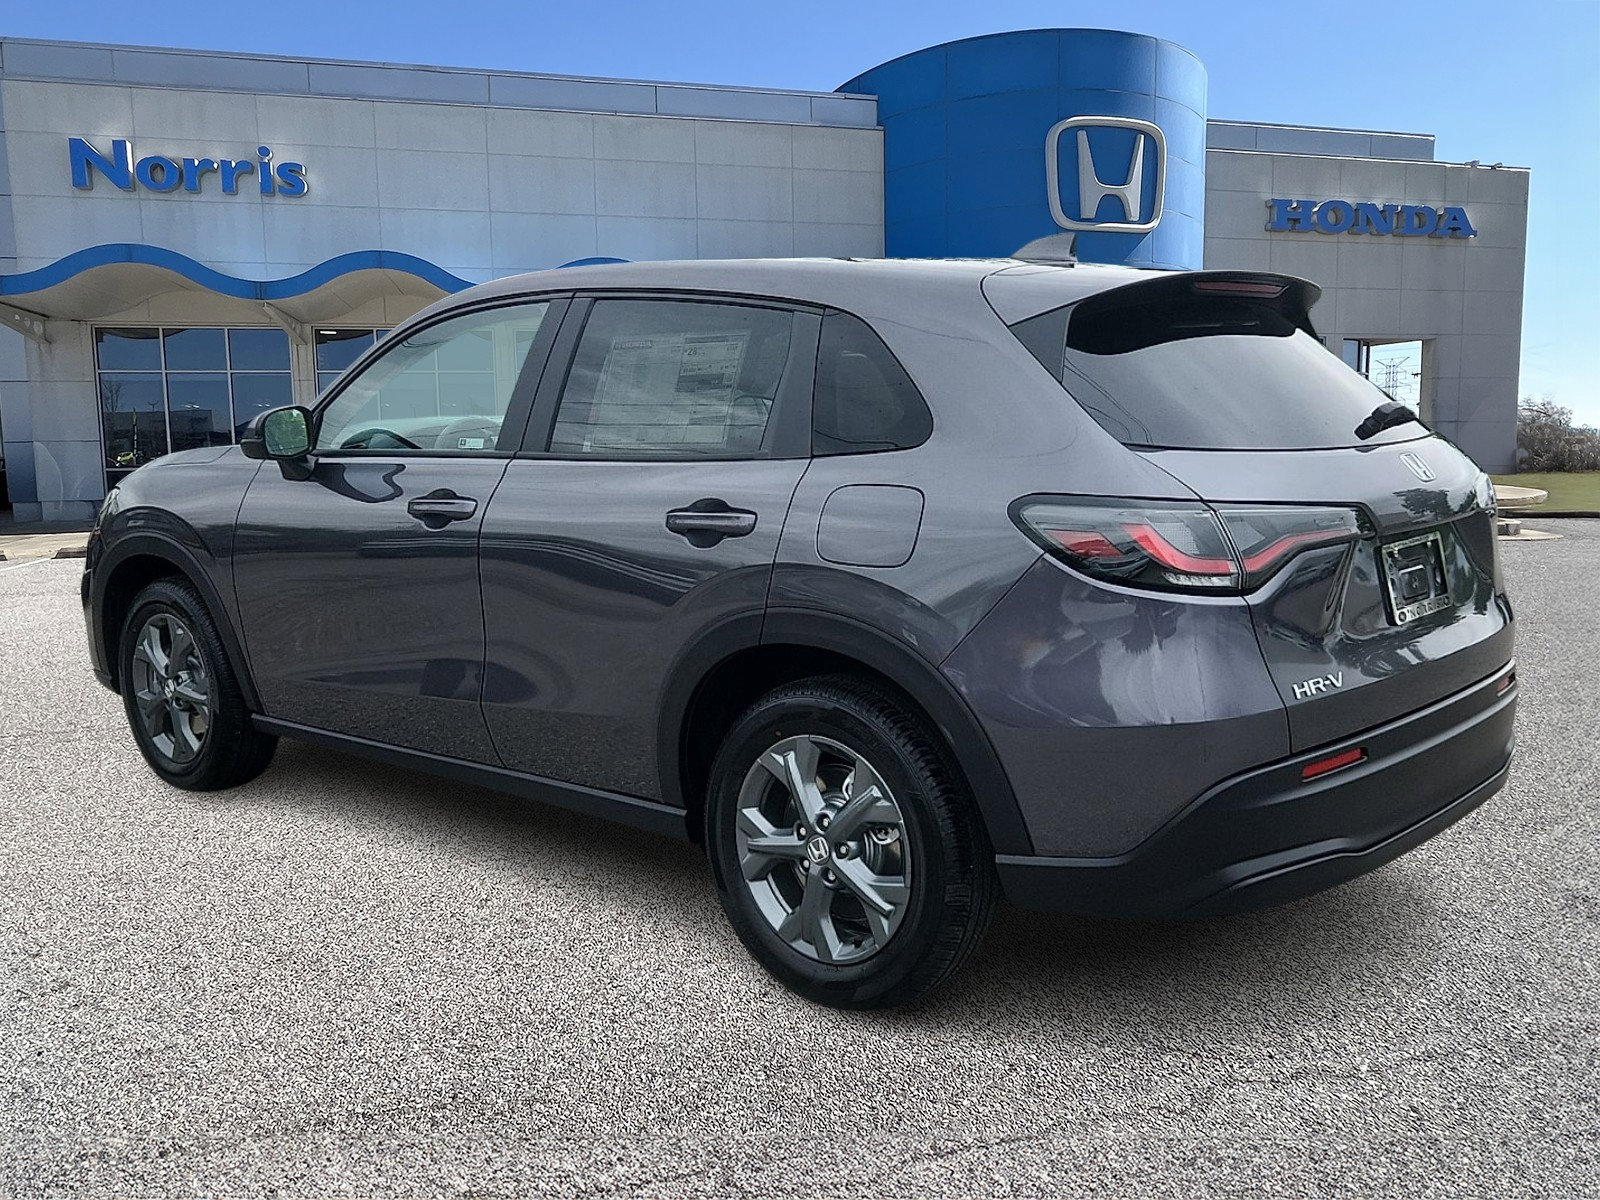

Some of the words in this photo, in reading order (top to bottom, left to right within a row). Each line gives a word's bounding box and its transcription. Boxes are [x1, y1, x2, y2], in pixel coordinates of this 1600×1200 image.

[68, 137, 310, 197] Norris
[1265, 198, 1477, 239] HONDA
[1292, 671, 1343, 699] HR-V
